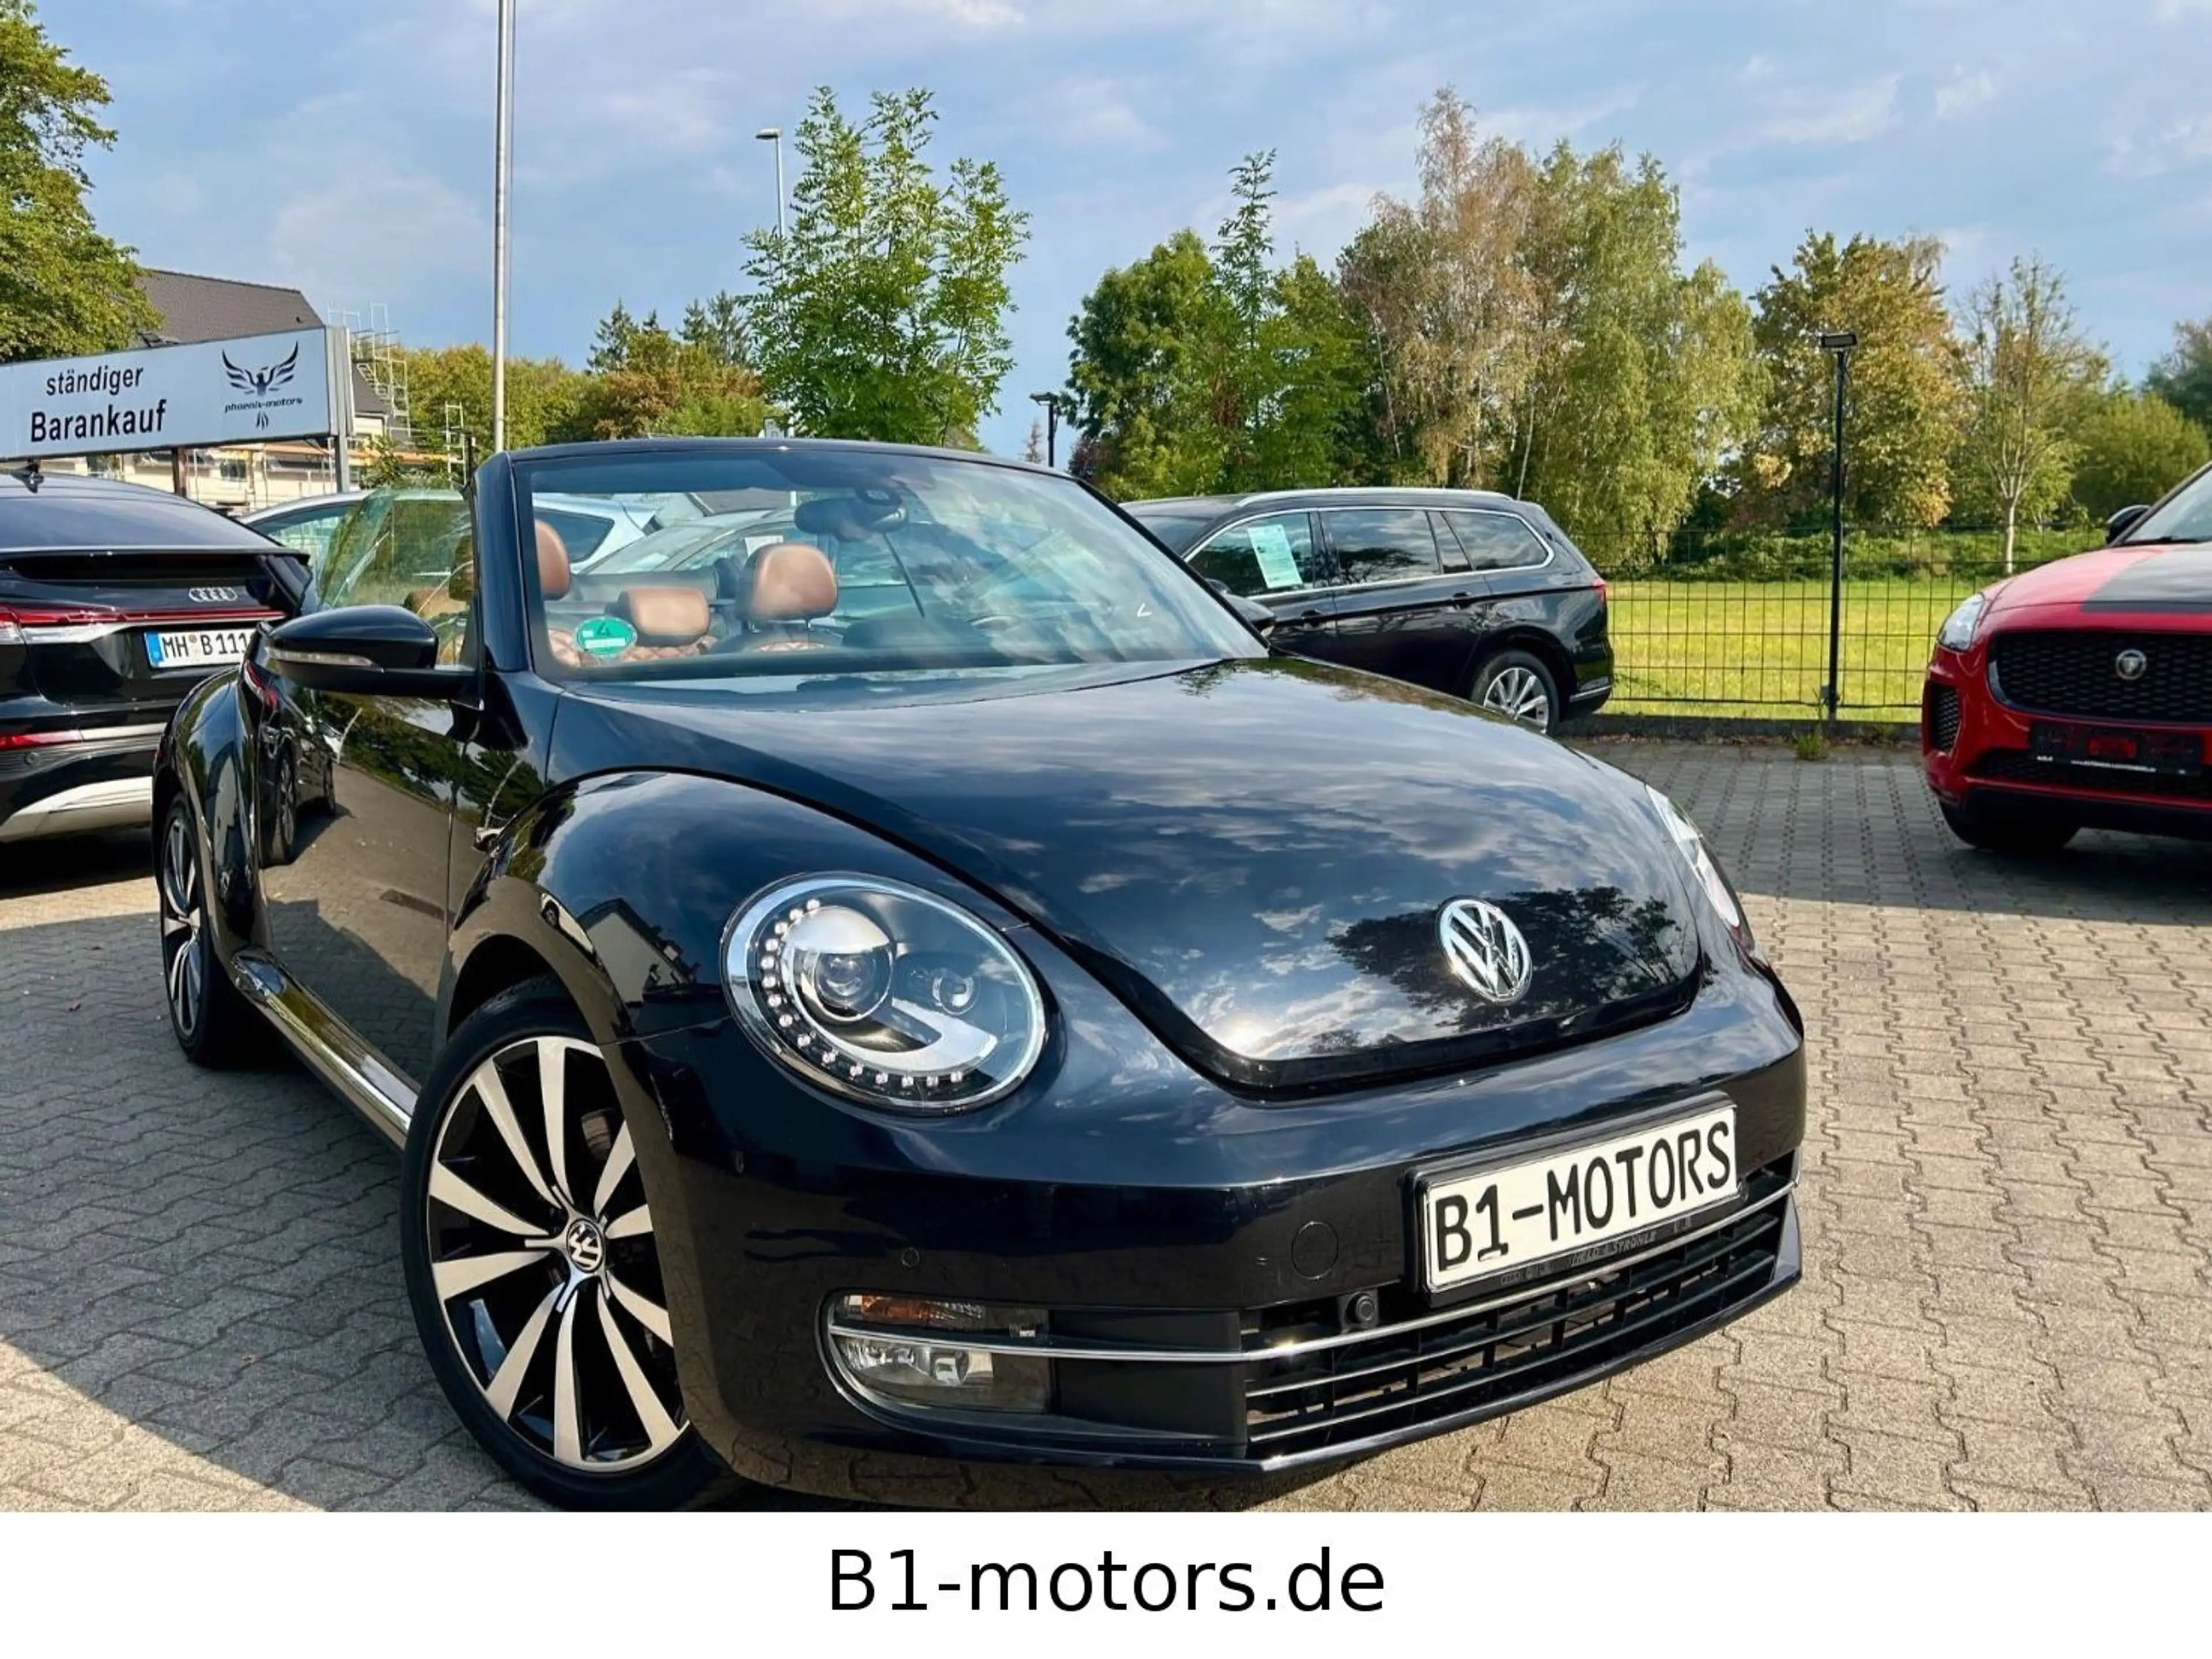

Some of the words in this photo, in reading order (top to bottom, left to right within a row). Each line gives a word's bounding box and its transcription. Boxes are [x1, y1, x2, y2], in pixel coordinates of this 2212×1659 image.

[46, 365, 143, 396] ständiger
[31, 399, 167, 442] Barankauf
[162, 636, 189, 658] MH
[1435, 1122, 1730, 1272] B1-MOTORS
